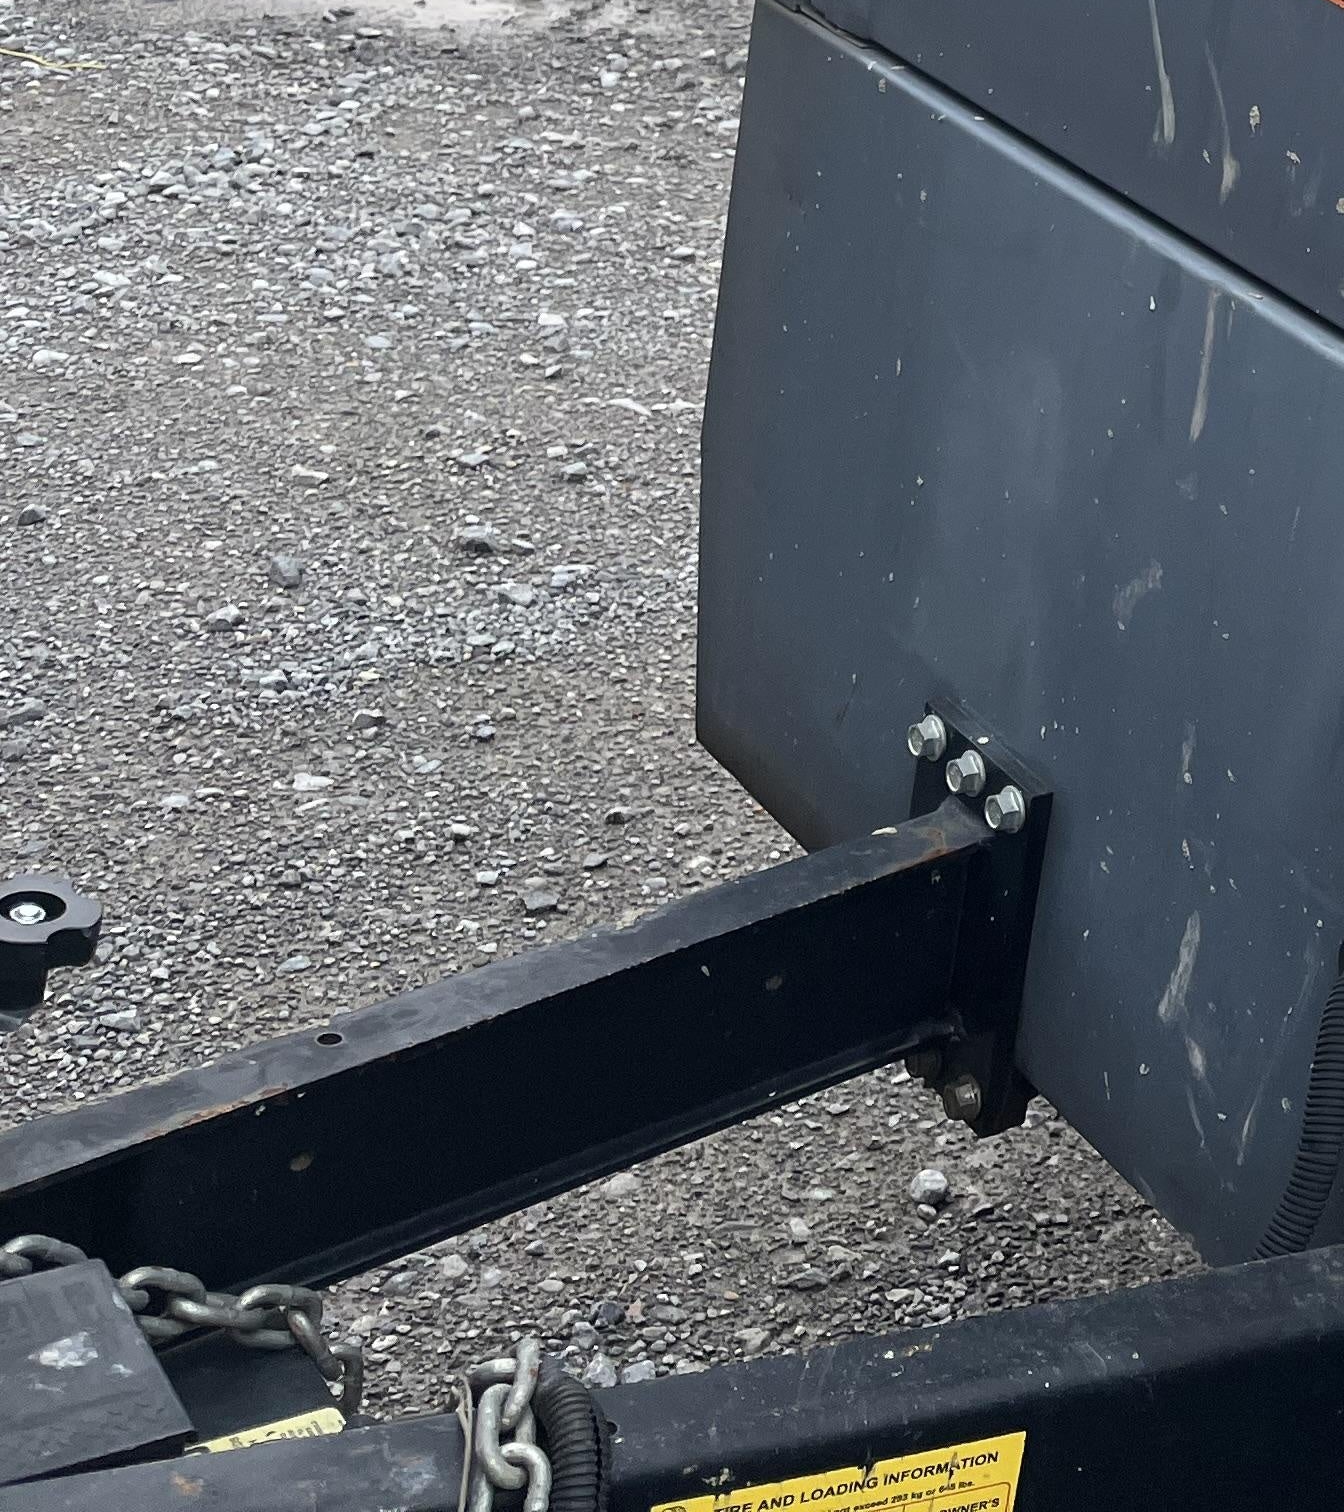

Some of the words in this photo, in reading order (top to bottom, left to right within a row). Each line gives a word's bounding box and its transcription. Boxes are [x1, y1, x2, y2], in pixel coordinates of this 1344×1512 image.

[714, 1502, 753, 1512] RE
[757, 1492, 795, 1512] AND
[800, 1478, 879, 1503] LOADING
[883, 1451, 999, 1486] INFORMATION
[925, 1489, 936, 1497] or
[939, 1497, 1000, 1512] WNER'S
